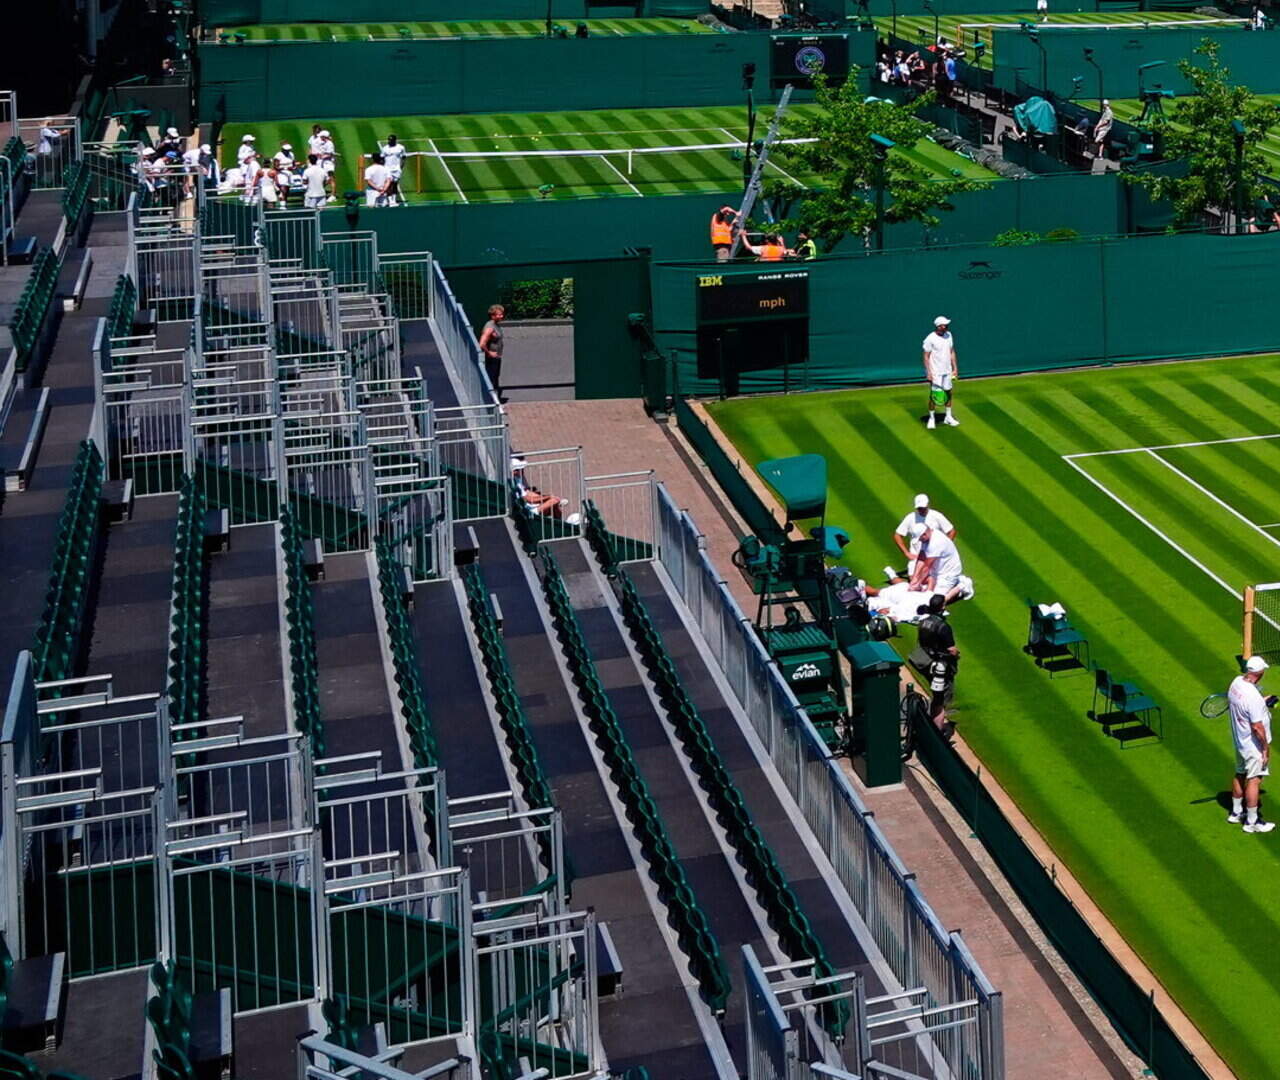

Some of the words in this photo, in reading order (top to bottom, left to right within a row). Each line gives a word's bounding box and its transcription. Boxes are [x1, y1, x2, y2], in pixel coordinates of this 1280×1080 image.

[699, 275, 723, 287] IBM
[759, 297, 785, 309] mph
[792, 668, 821, 680] evian
